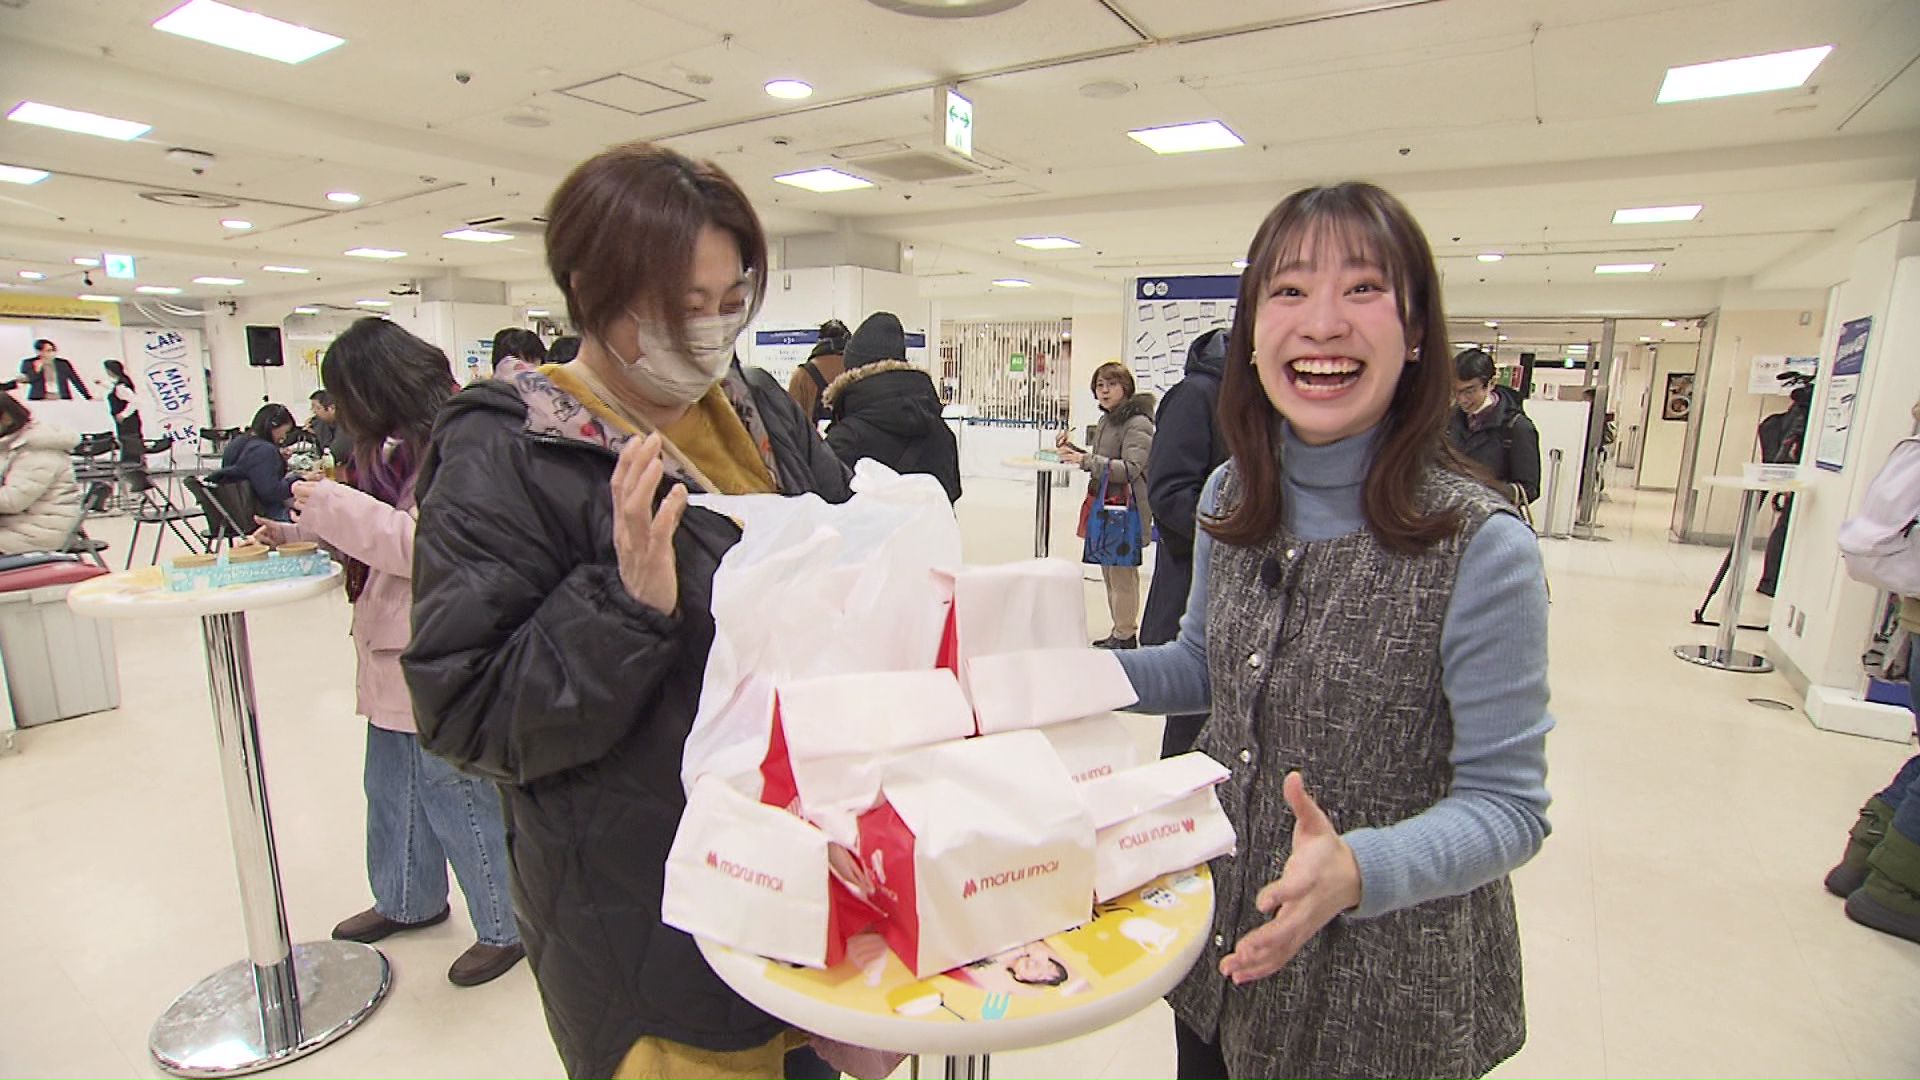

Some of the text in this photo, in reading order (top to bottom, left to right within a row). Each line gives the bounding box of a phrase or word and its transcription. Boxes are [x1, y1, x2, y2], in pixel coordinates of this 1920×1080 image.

[147, 370, 179, 411] LAND
[164, 367, 193, 404] MILK
[720, 859, 784, 893] marui imai
[980, 859, 1059, 891] marui imai
